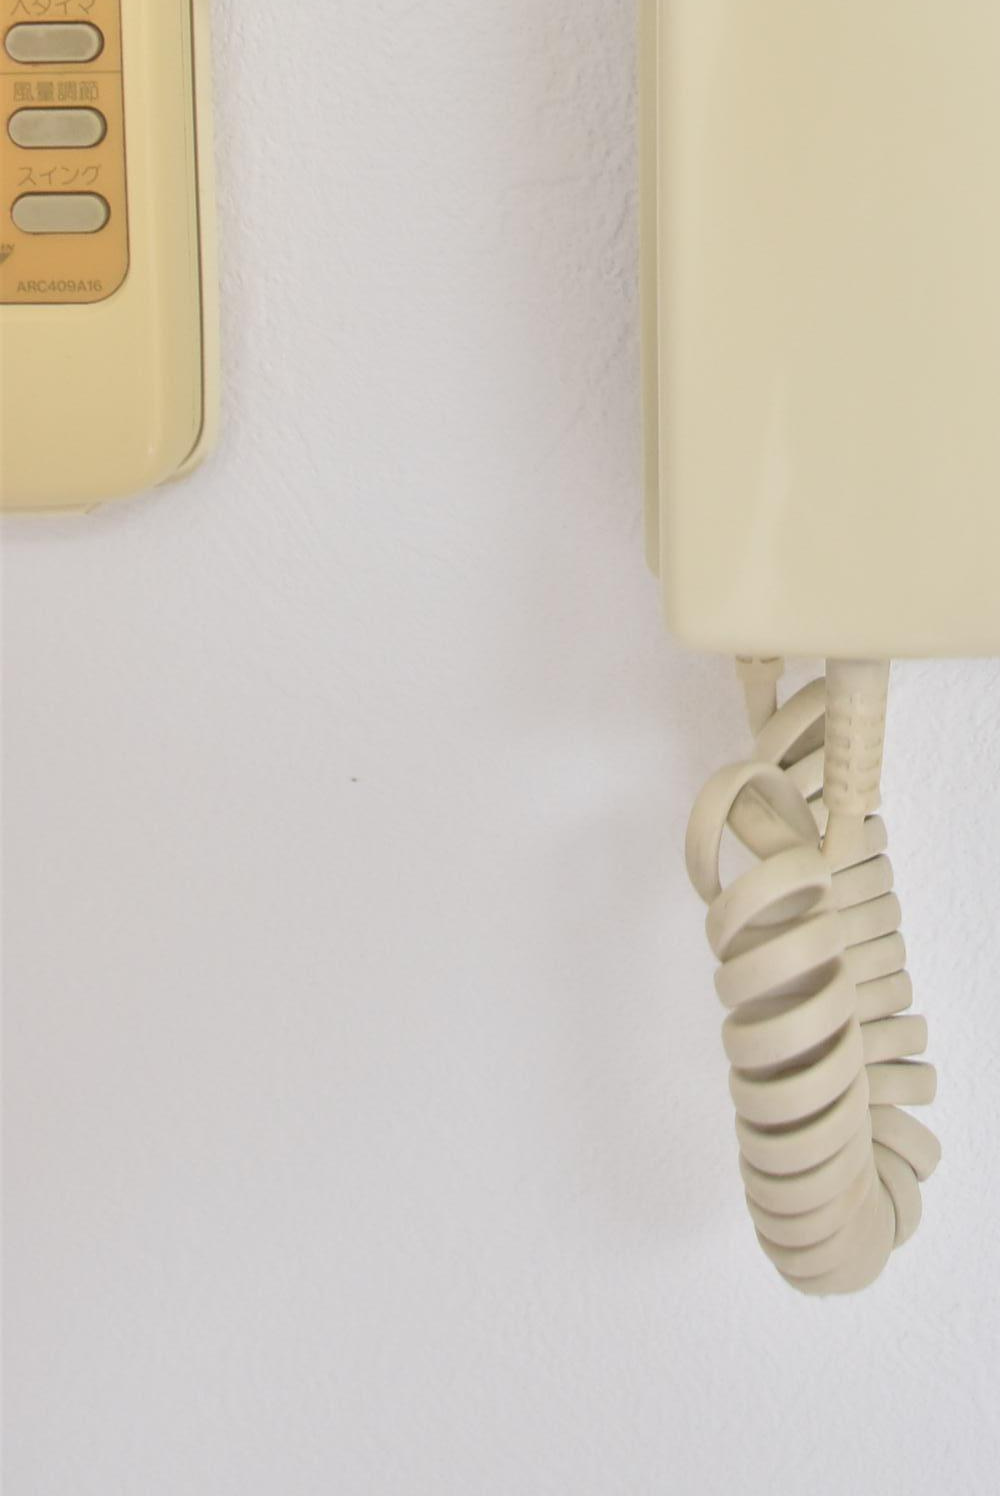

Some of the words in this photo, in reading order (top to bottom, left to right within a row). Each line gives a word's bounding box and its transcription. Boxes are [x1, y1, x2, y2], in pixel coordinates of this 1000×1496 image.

[13, 81, 99, 103] 風量調節
[18, 166, 101, 186] スイング
[17, 280, 103, 294] ARC409A16
